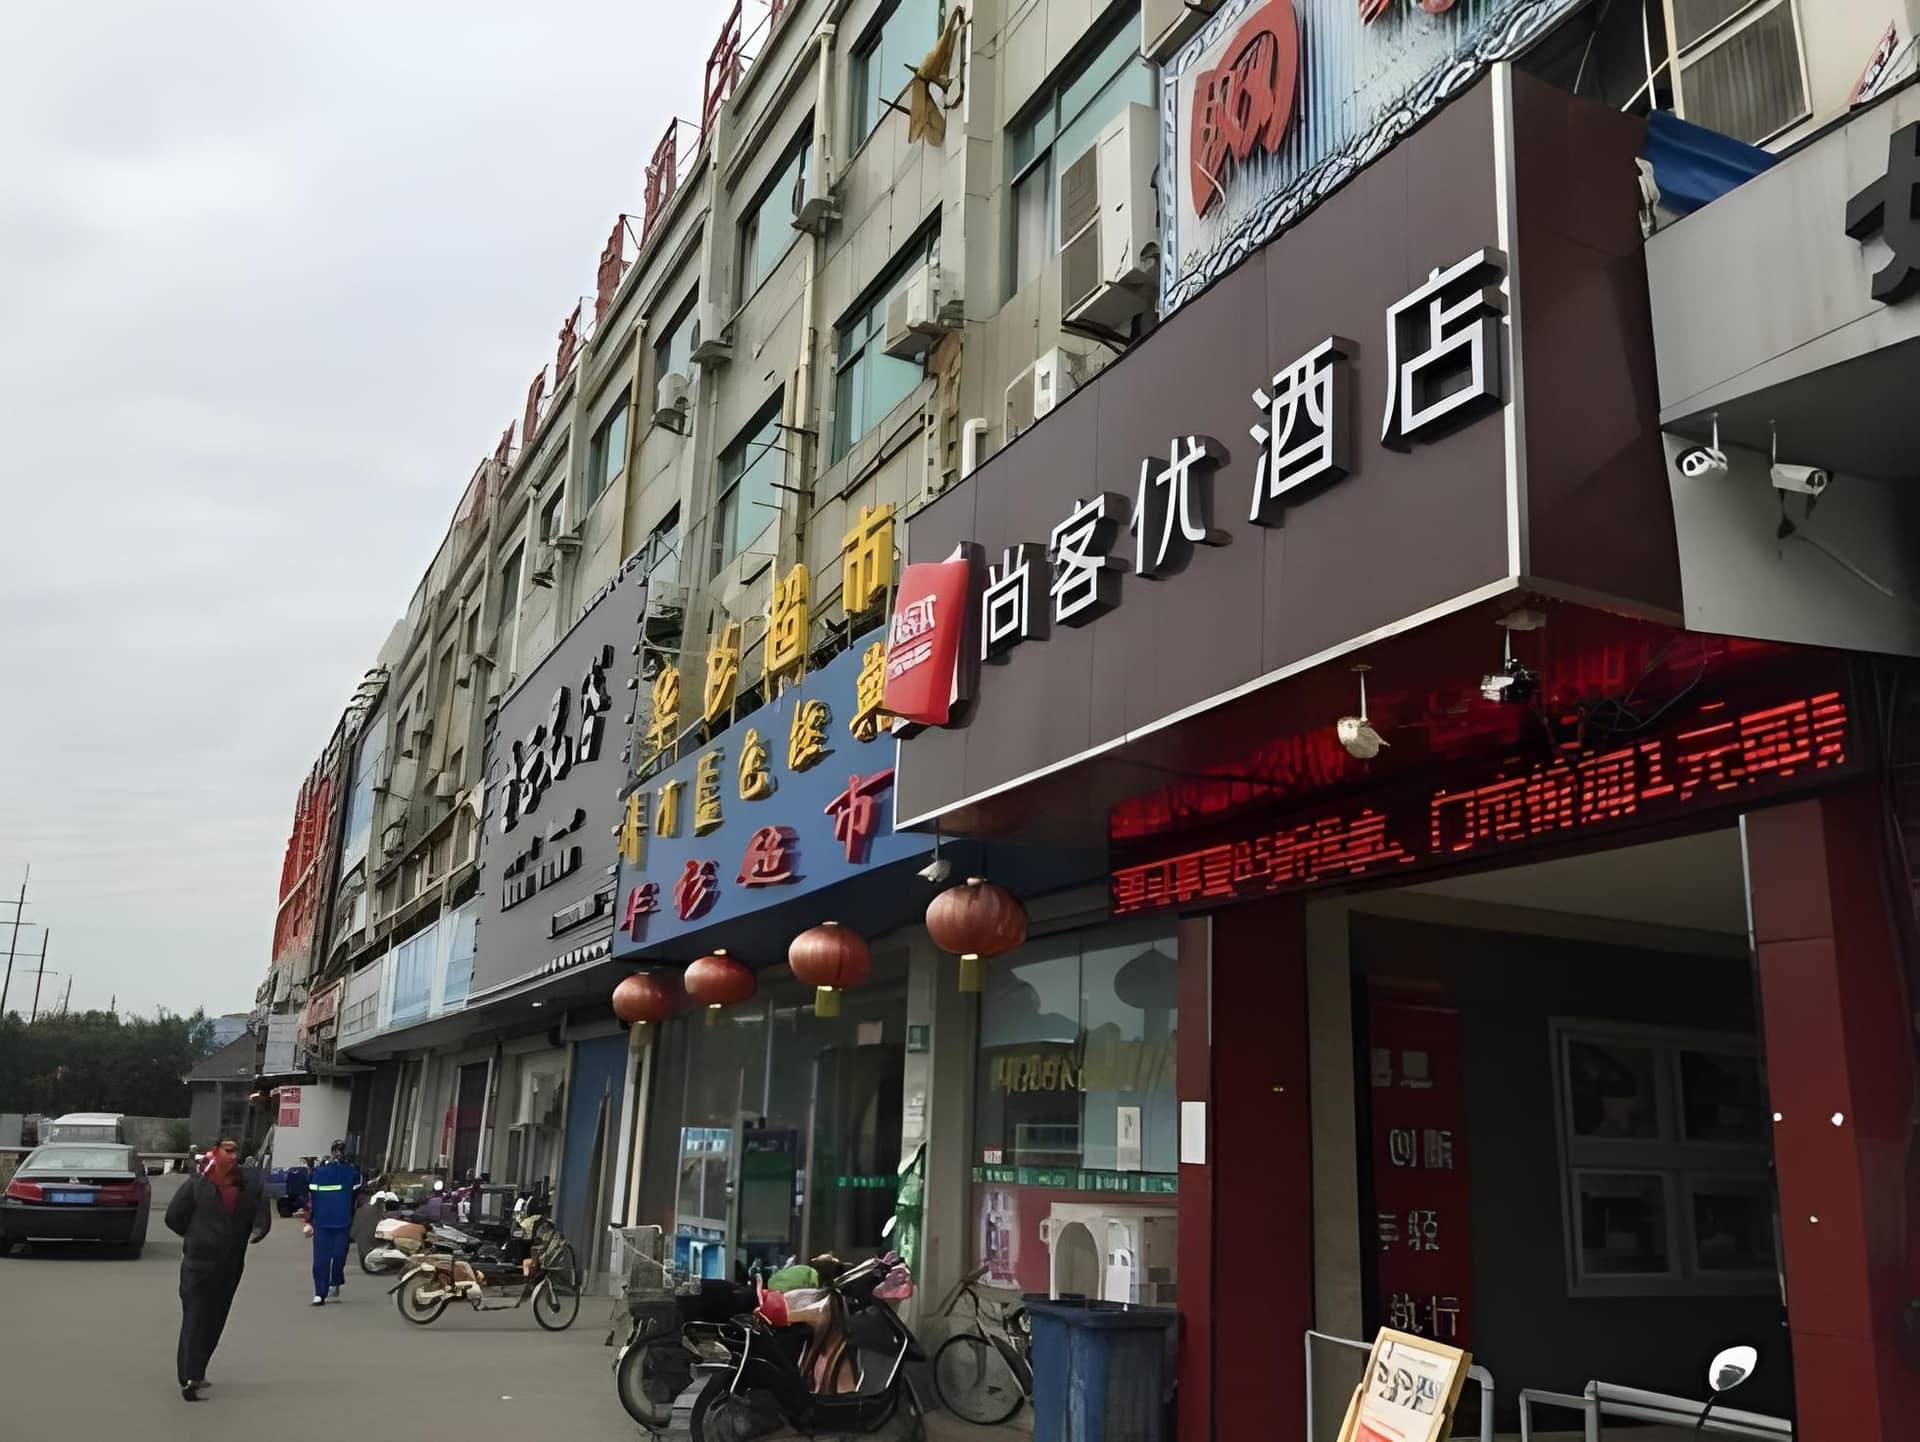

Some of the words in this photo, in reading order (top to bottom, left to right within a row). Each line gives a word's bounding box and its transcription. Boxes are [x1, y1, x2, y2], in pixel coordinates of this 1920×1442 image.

[979, 246, 1506, 662] 尚客优酒店
